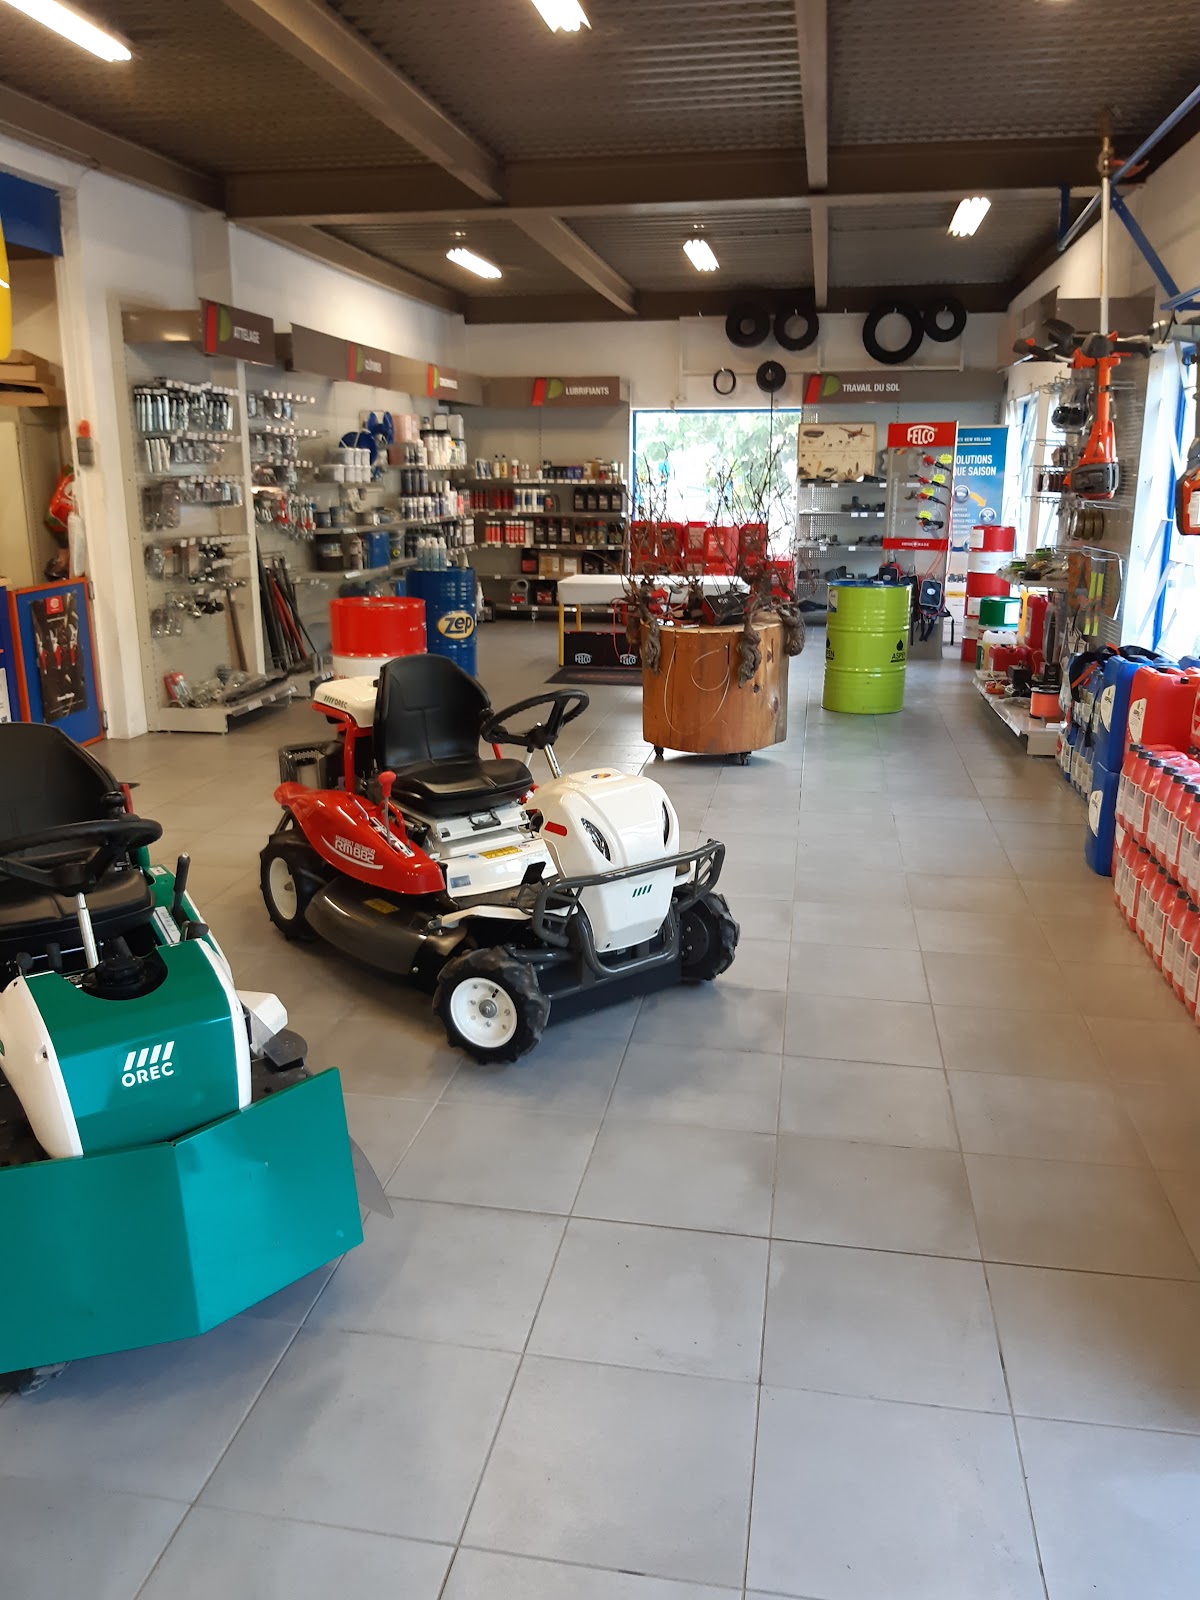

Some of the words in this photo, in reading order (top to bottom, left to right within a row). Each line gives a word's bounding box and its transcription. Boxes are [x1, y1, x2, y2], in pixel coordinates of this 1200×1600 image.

[233, 326, 260, 345] ATTELAGE
[565, 386, 610, 396] LUBRIFIANTS
[842, 383, 872, 392] TRAVAIL
[873, 383, 885, 392] DU
[885, 383, 900, 392] SOL
[907, 425, 936, 445] FELCO
[956, 454, 993, 465] OLUTIONS
[967, 466, 997, 477] SAISON
[575, 653, 592, 665] FELCO
[334, 698, 348, 709] OREC
[121, 1062, 175, 1088] OREC
